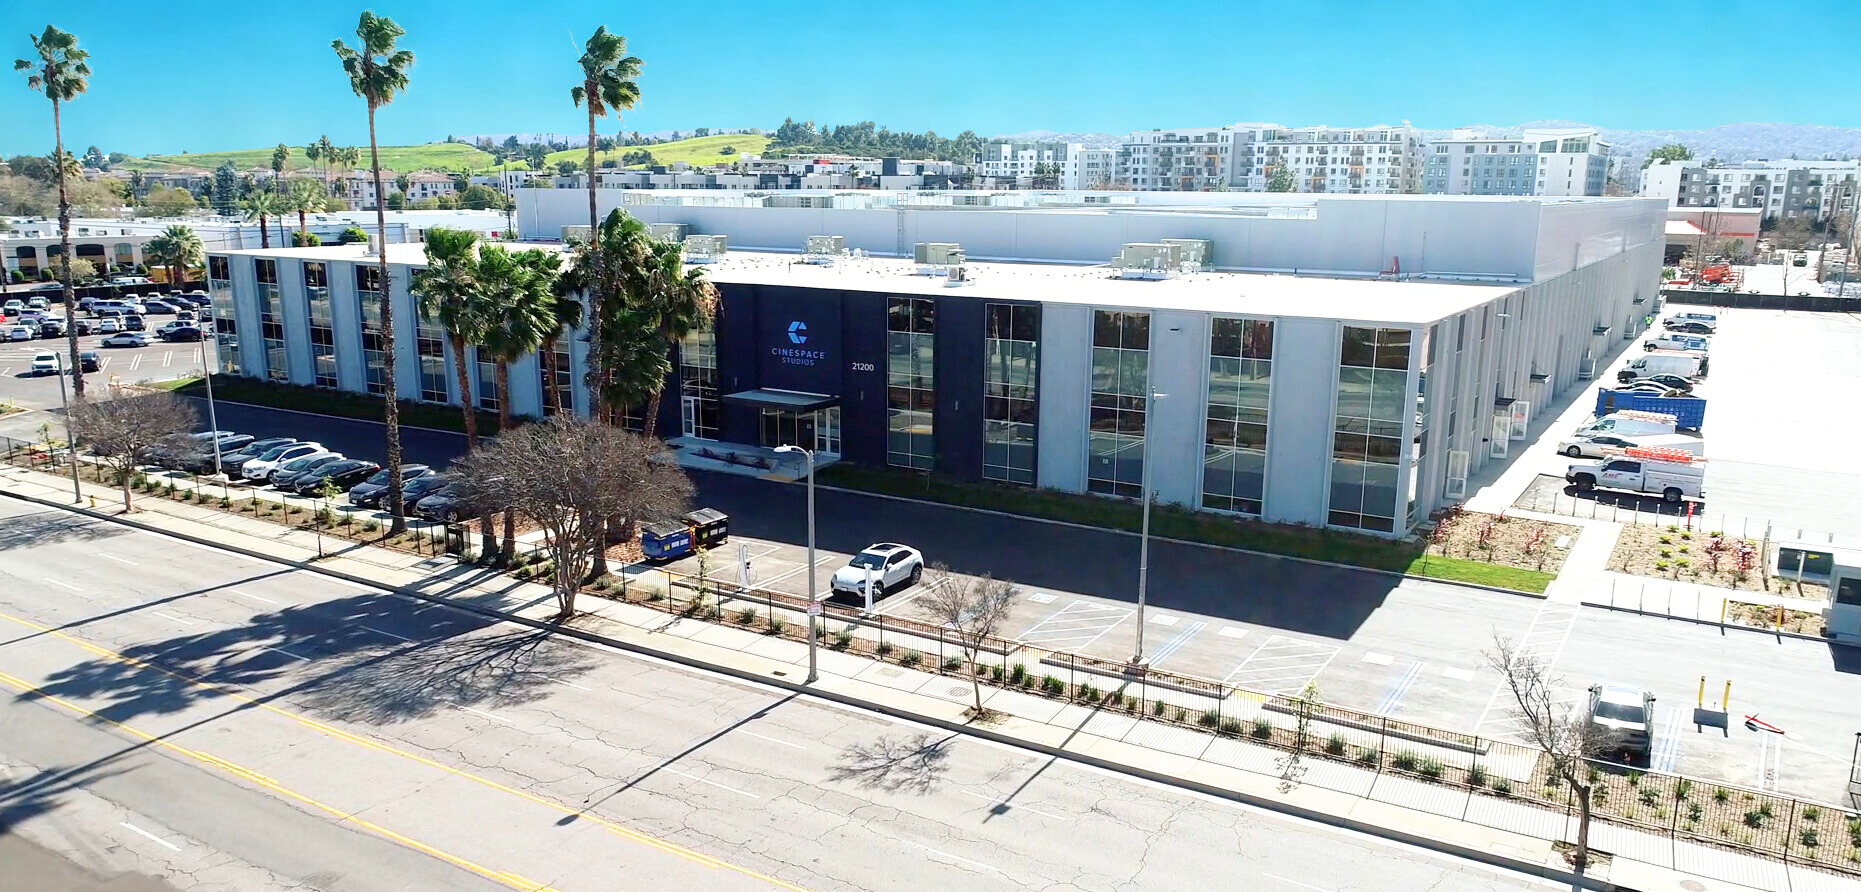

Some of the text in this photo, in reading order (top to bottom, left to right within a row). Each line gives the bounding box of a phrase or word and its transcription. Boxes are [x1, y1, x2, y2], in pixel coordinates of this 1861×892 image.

[771, 347, 825, 359] CINESPACE
[782, 357, 815, 366] STUDIOS
[852, 362, 875, 372] 21200
